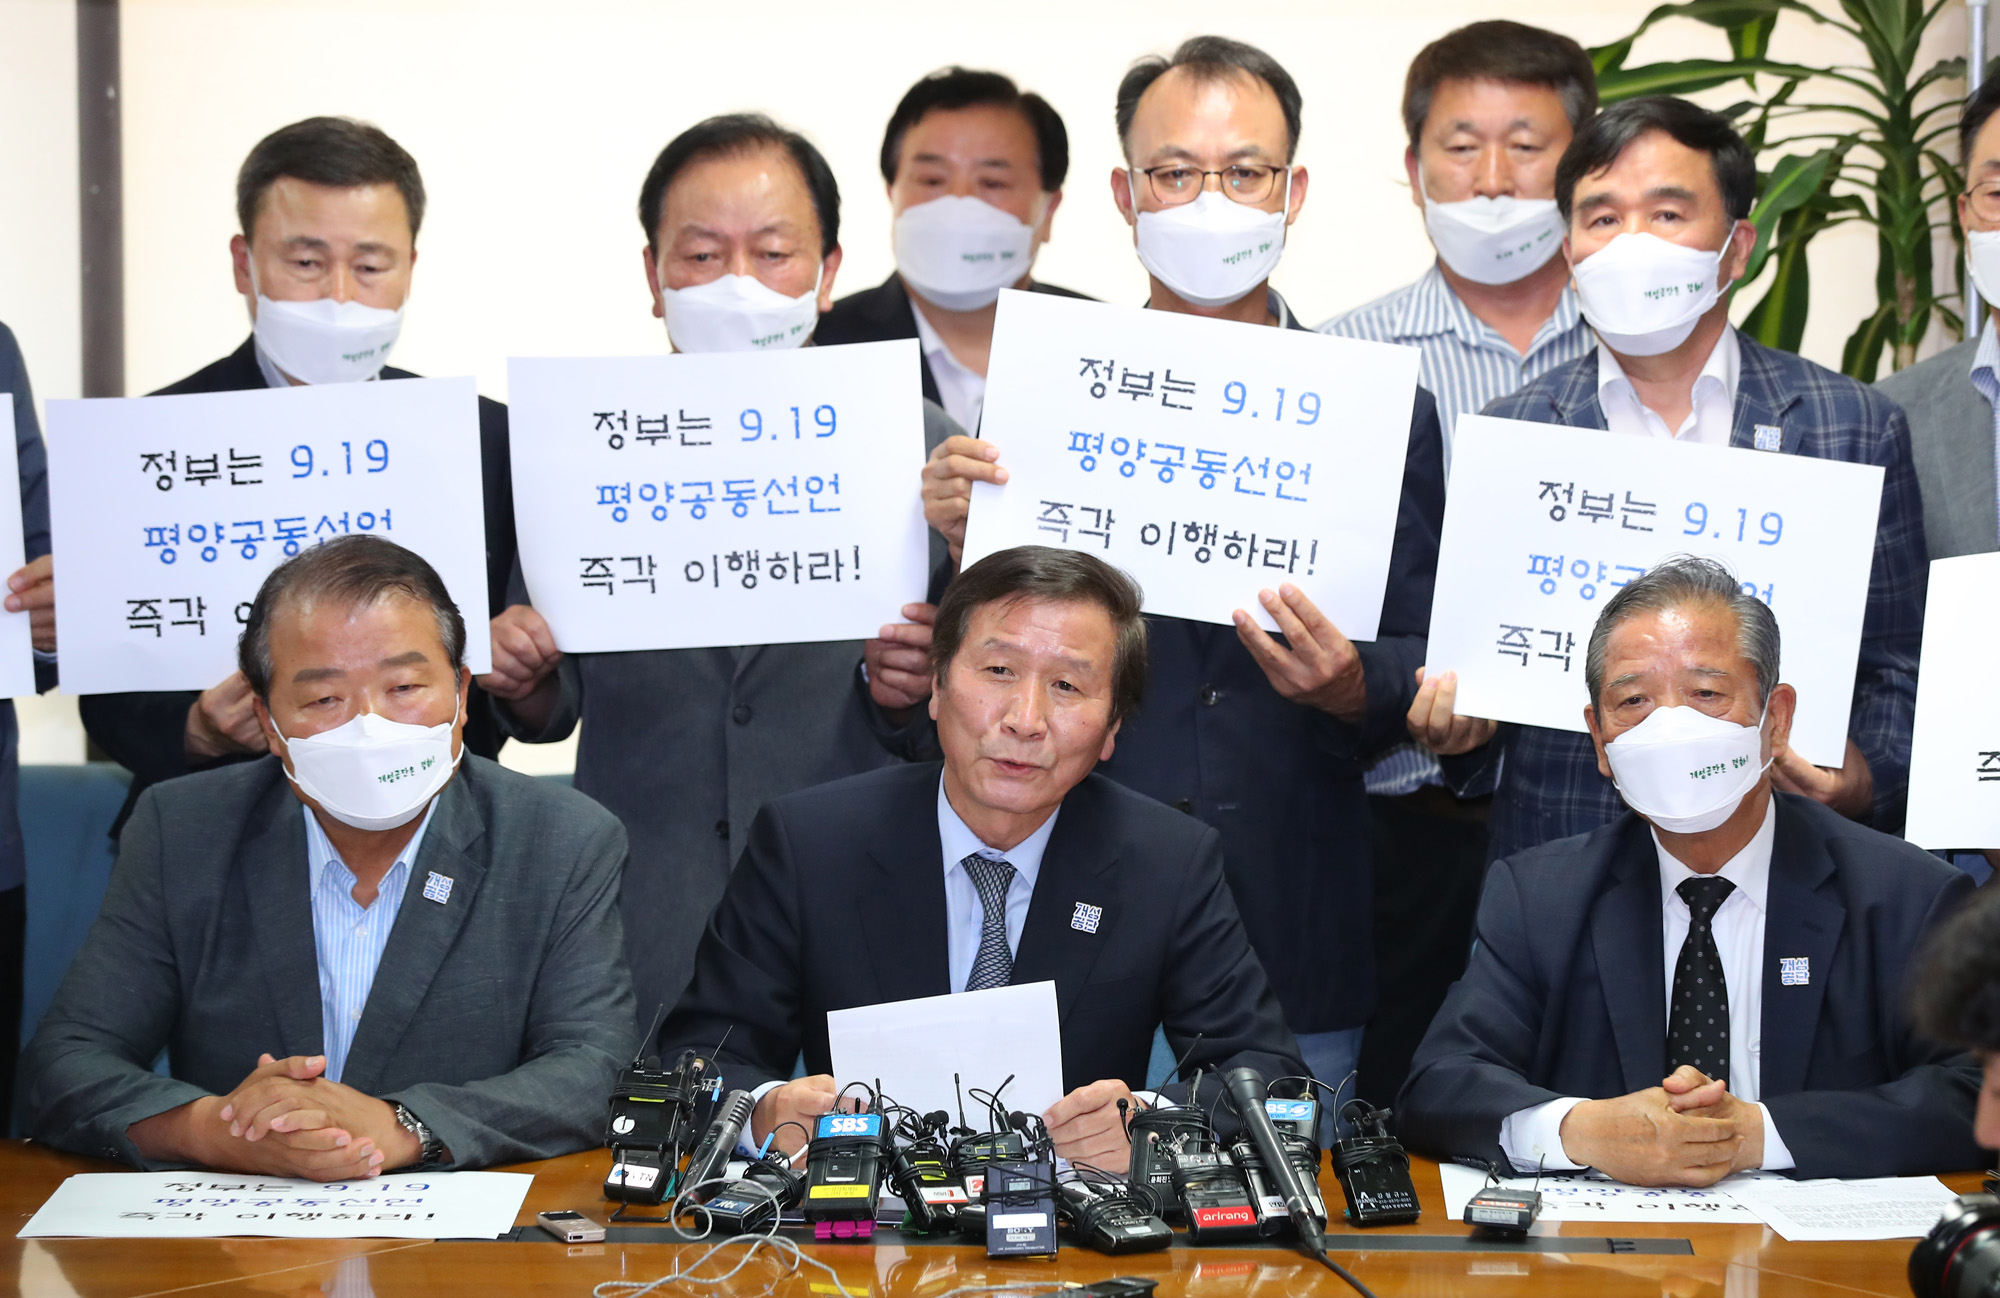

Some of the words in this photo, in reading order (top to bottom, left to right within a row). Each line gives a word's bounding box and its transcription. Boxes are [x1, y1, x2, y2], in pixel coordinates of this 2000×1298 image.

[1079, 357, 1196, 410] 정부는
[1222, 381, 1321, 425] 9.19
[592, 409, 712, 450] 정부는
[739, 404, 837, 442] 9.19
[140, 448, 263, 492] 정부는
[290, 439, 390, 479] 9.19
[1068, 430, 1313, 503] 평양공동선언
[596, 473, 841, 523] 평양공동선언
[1538, 480, 1657, 532] 정부는
[1683, 501, 1784, 546] 9.19
[1036, 500, 1116, 549] 즉각
[1140, 521, 1319, 576] 이행하라!
[580, 555, 657, 595] 즉각
[684, 545, 861, 589] 이행하라!
[126, 596, 207, 638] 즉각
[1496, 624, 1576, 672] 즉각
[1781, 959, 1808, 971] 개성
[830, 1117, 869, 1133] SBS
[1266, 1103, 1287, 1113] BS
[164, 1182, 293, 1192] 정부는
[322, 1183, 431, 1192] 9.19
[632, 1171, 654, 1181] TN
[118, 1212, 207, 1221] 즉각
[236, 1212, 435, 1221] 이행하라!
[152, 1198, 424, 1207] 평양공동선언
[1202, 1211, 1249, 1221] arirang
